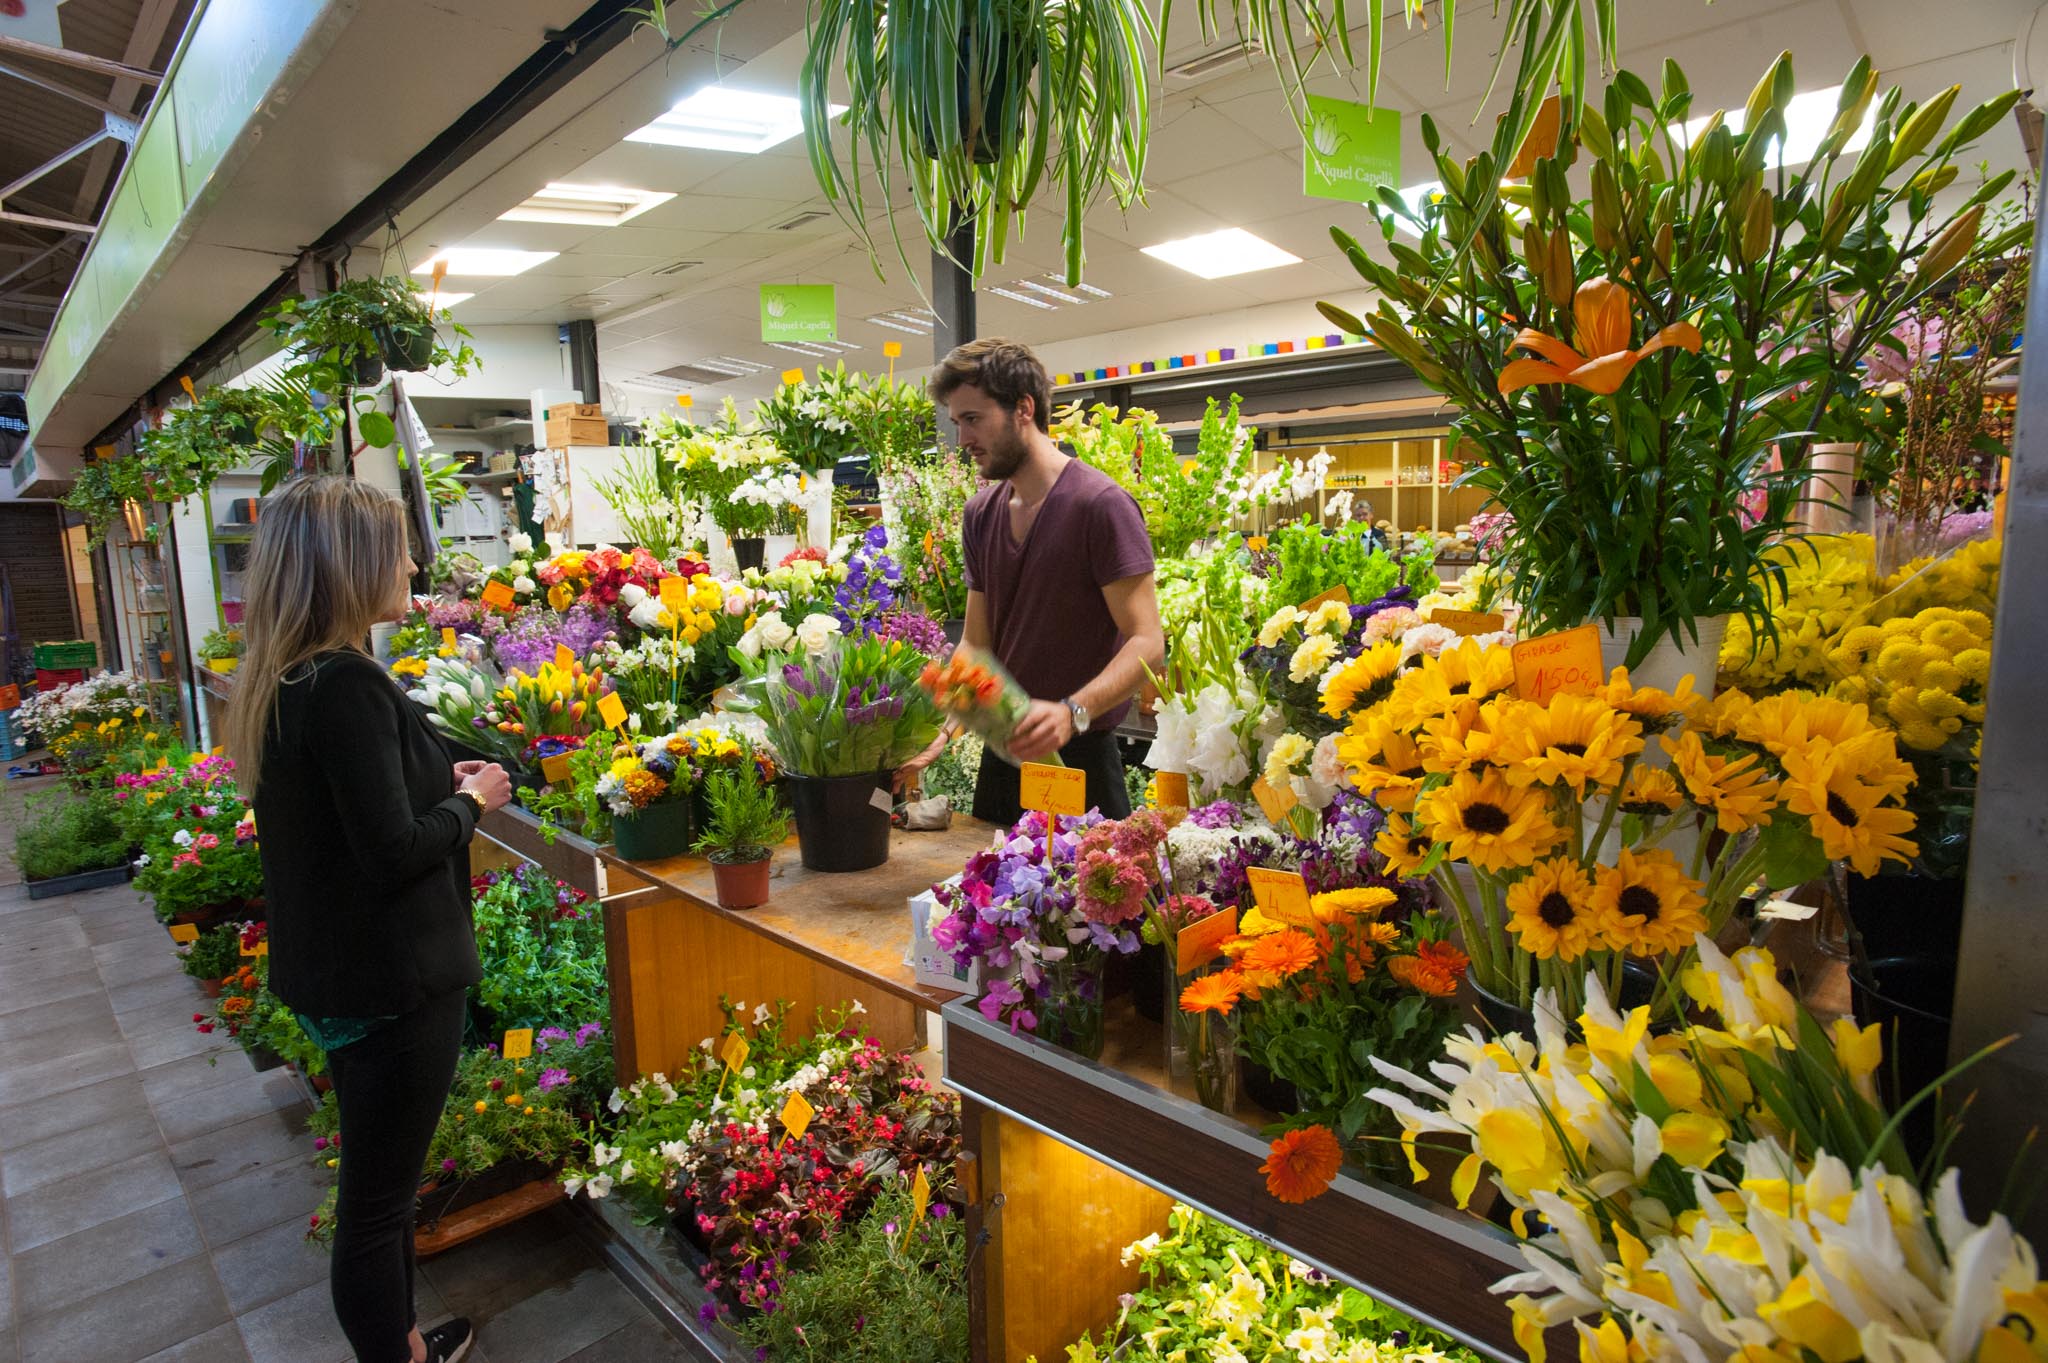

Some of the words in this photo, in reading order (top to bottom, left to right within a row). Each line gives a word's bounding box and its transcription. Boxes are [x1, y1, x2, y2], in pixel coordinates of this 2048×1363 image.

[1313, 161, 1353, 181] Miquel
[767, 320, 799, 332] Miquel
[1516, 640, 1570, 663] GIRASOL
